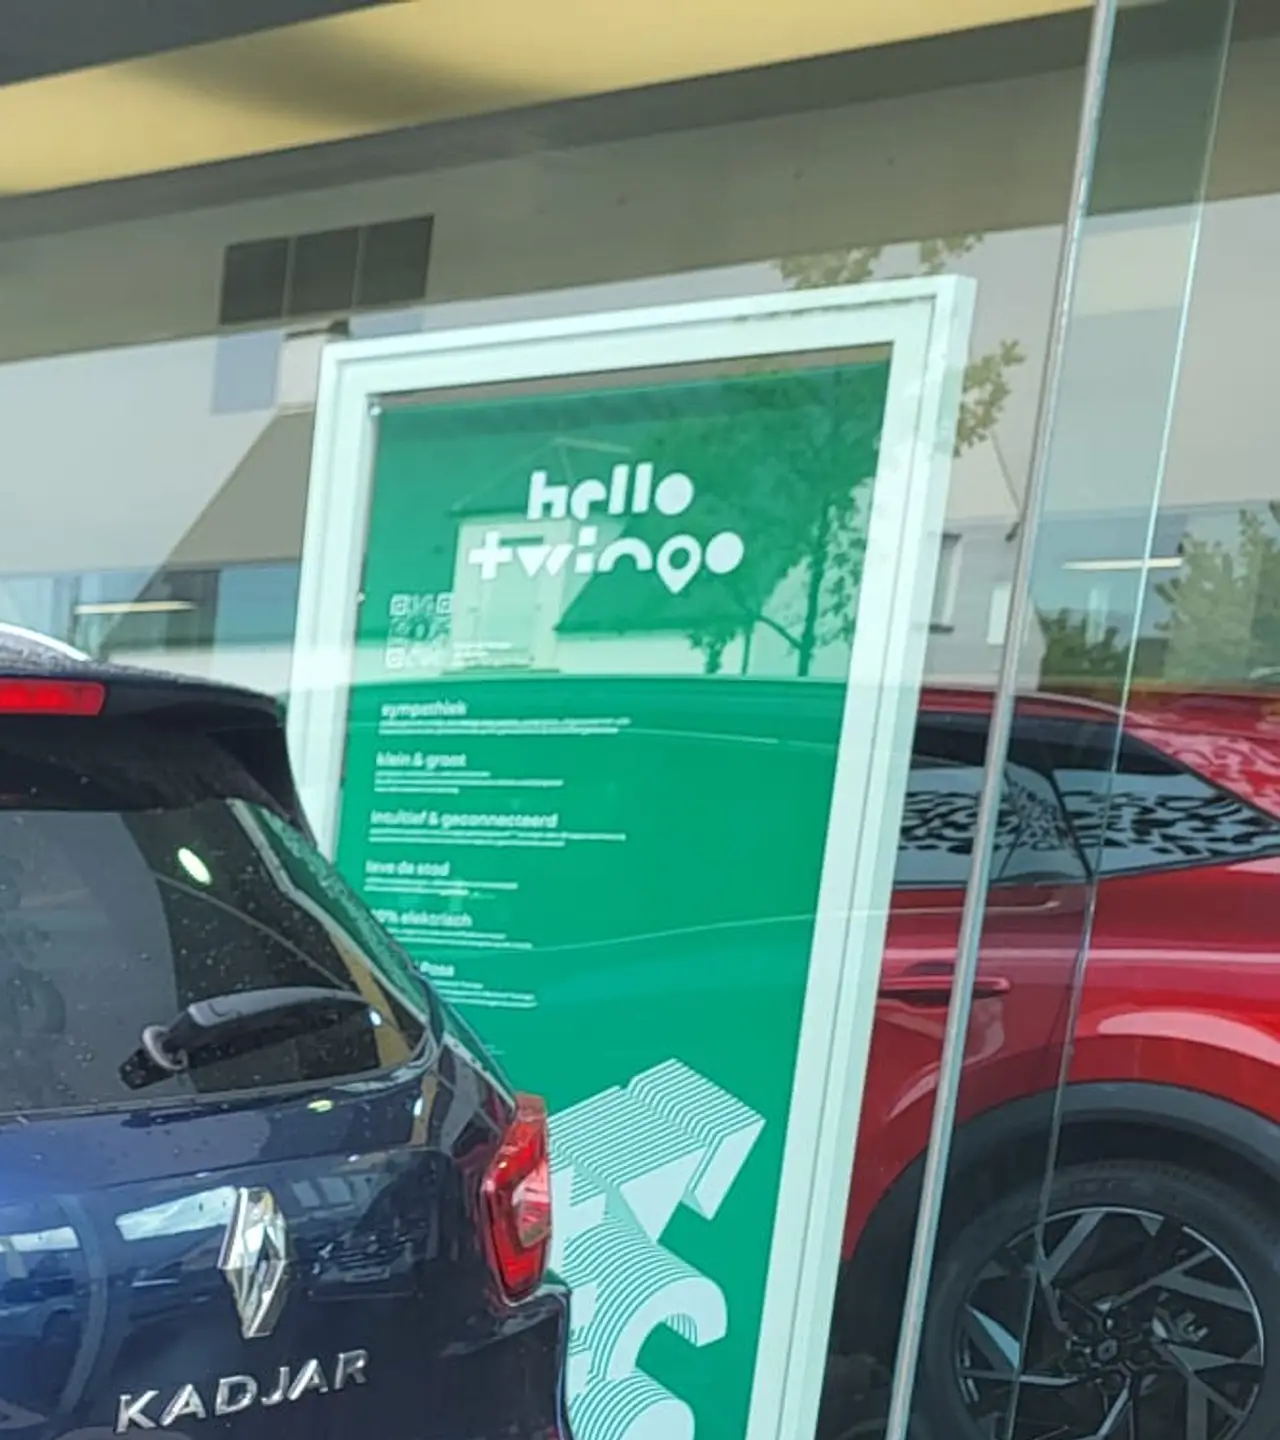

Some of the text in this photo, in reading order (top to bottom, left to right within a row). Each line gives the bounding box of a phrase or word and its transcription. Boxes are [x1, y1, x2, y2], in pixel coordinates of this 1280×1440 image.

[527, 461, 694, 521] hello
[468, 524, 745, 595] twingo
[380, 699, 468, 718] sympathiek
[412, 752, 423, 767] &
[427, 811, 438, 826] &
[113, 1348, 370, 1435] KADJAR
